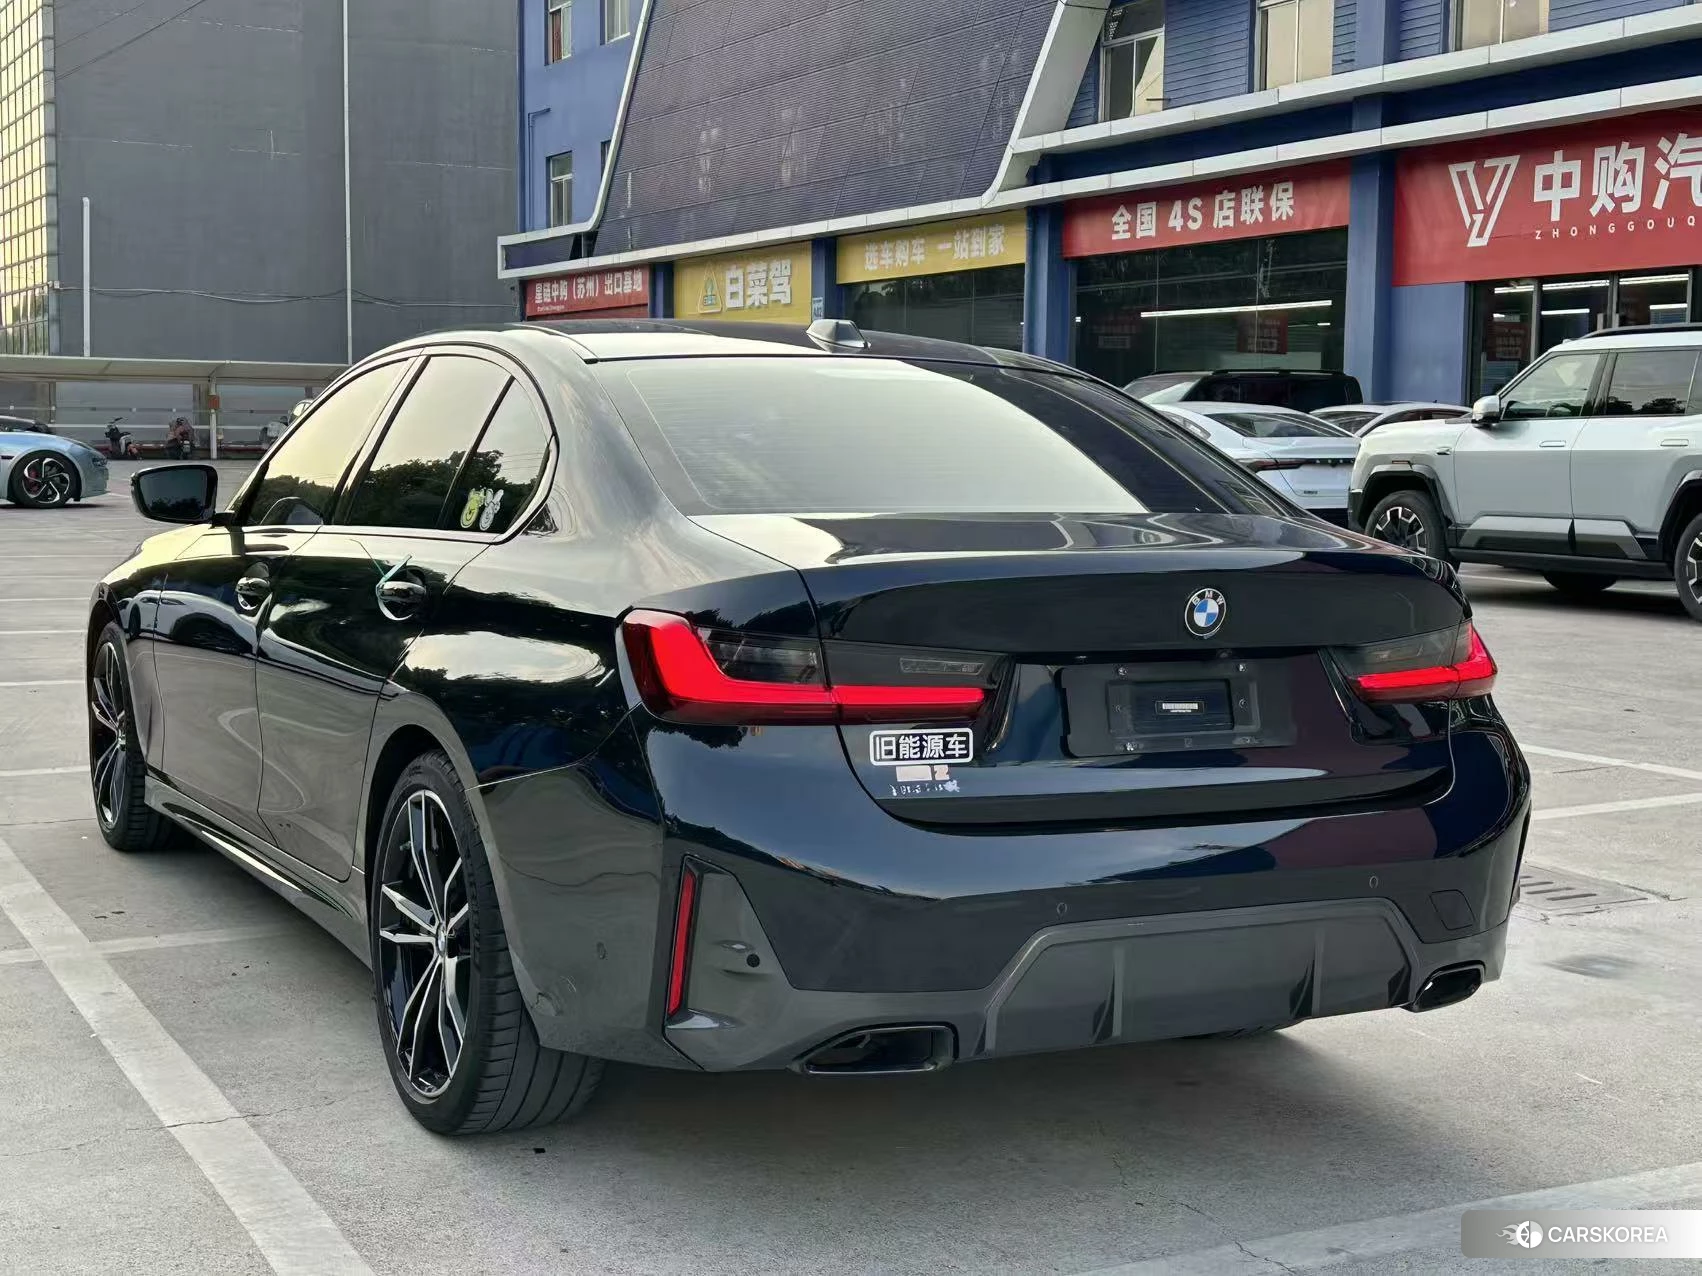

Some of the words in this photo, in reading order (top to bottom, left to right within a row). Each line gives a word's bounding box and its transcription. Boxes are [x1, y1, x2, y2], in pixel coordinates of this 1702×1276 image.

[1533, 133, 1702, 222] 中购汽
[725, 258, 792, 309] 白菜驾
[1192, 590, 1224, 606] BMW
[875, 733, 968, 761] 旧能源车
